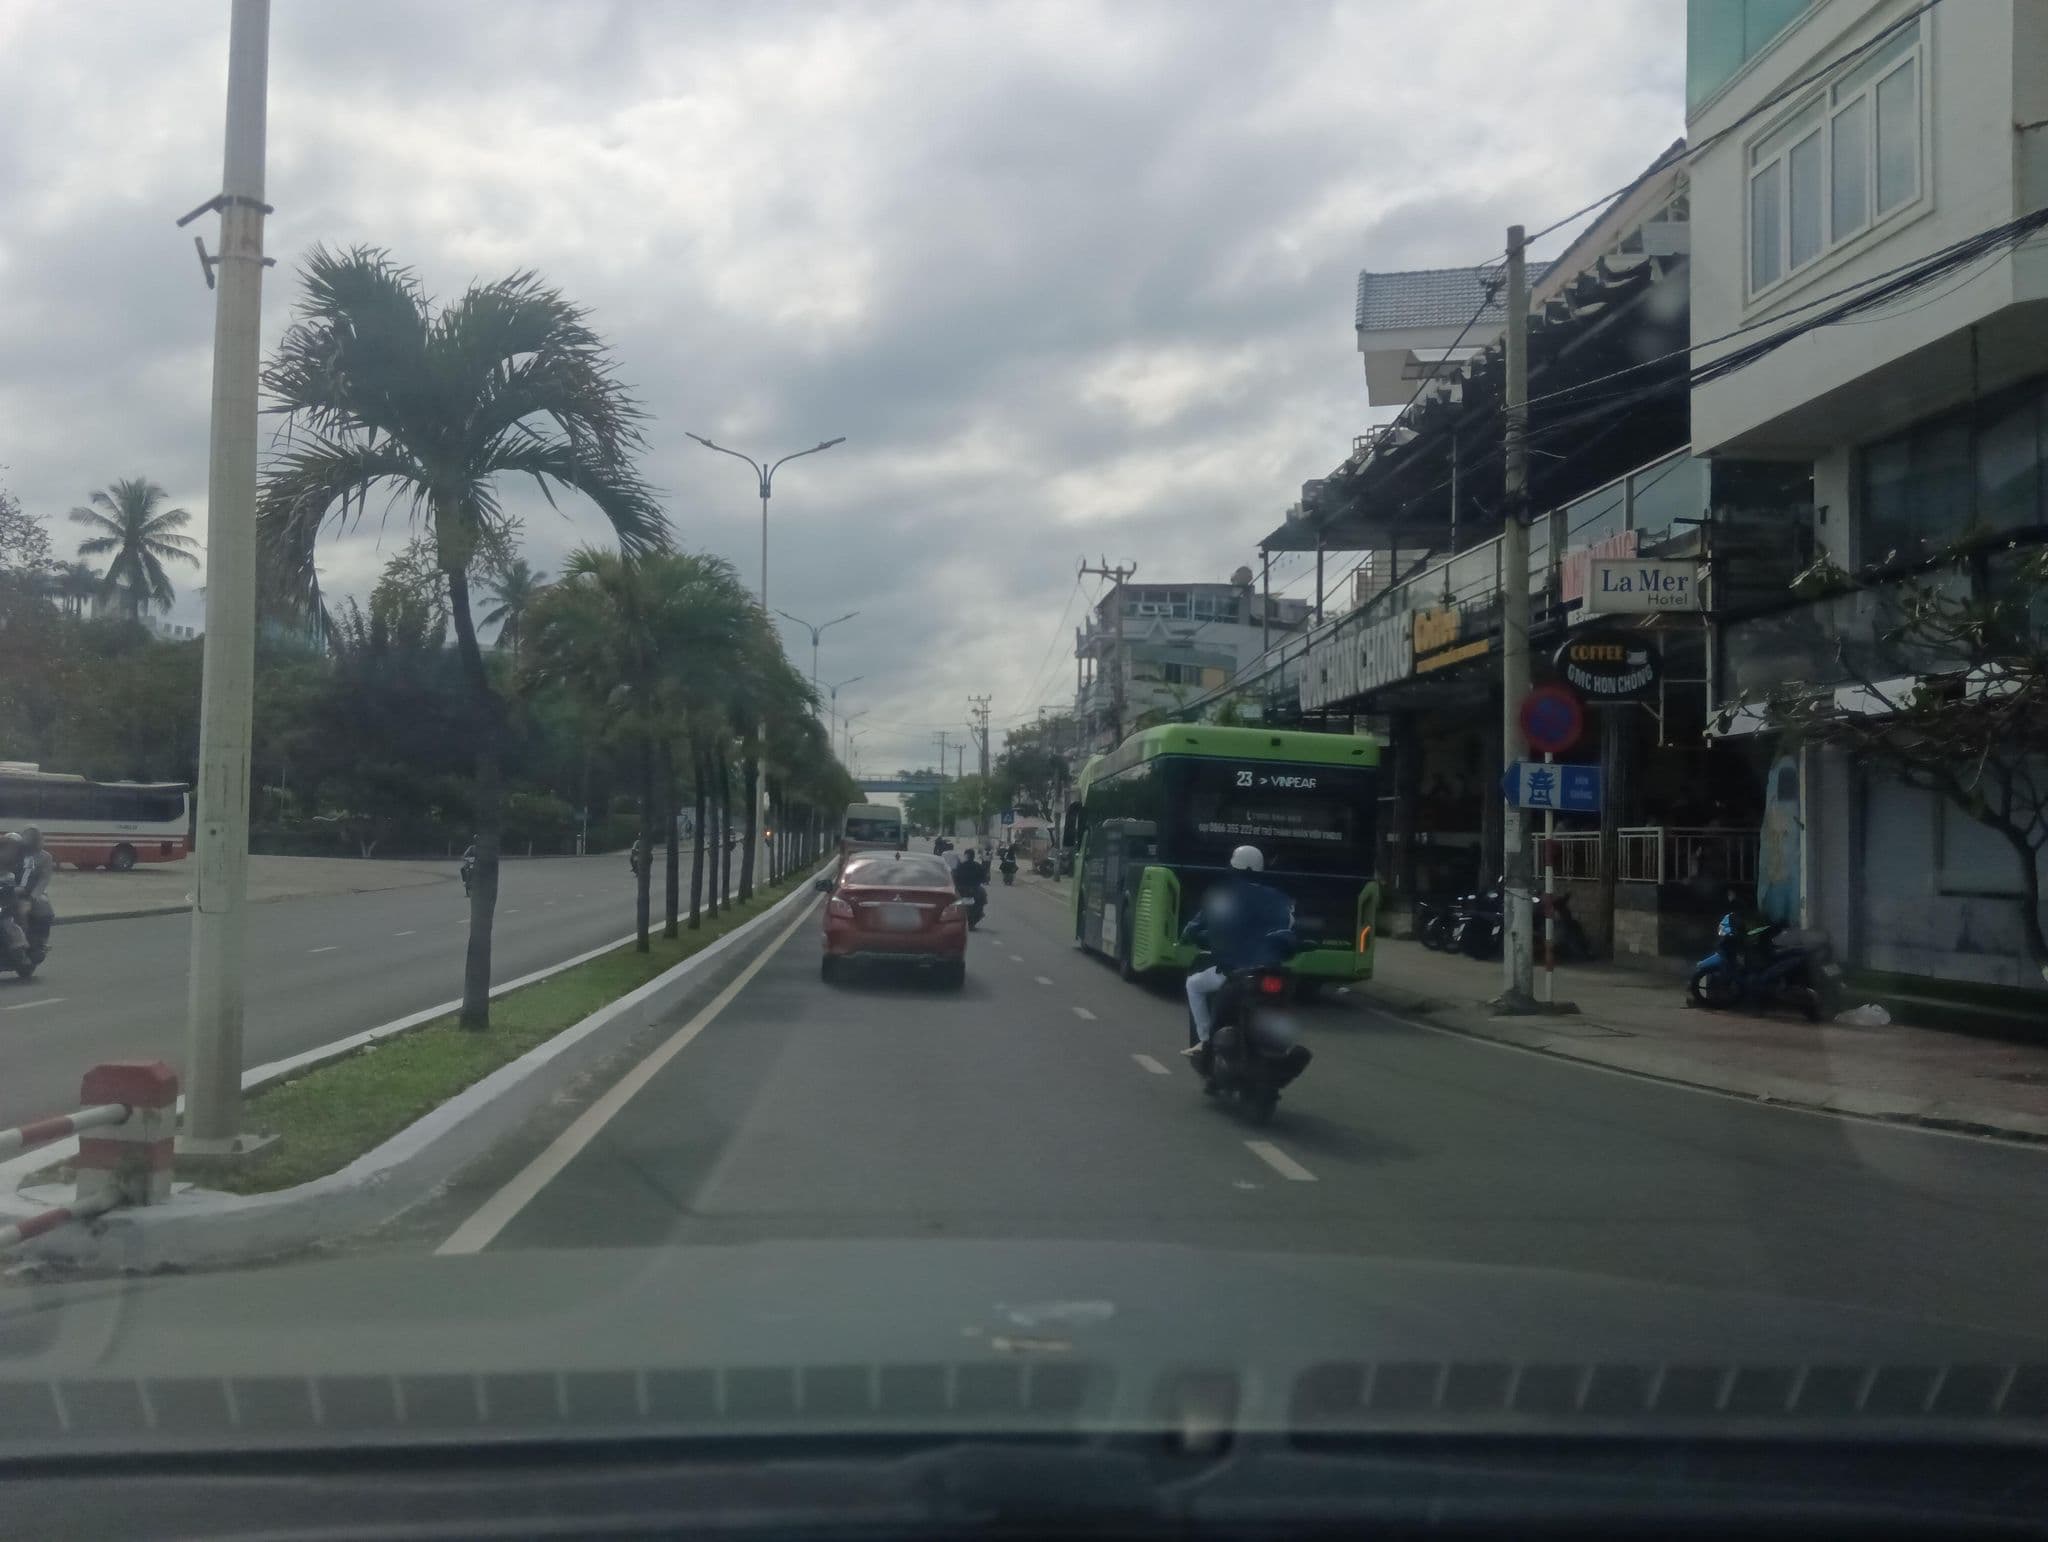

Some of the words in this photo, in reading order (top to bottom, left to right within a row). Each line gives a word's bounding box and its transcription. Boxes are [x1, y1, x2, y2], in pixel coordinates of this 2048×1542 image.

[1602, 568, 1632, 592] La
[1640, 568, 1689, 592] Mer
[1647, 593, 1688, 605] Hotel
[1569, 644, 1624, 661] COFFEE
[1236, 771, 1253, 787] 23
